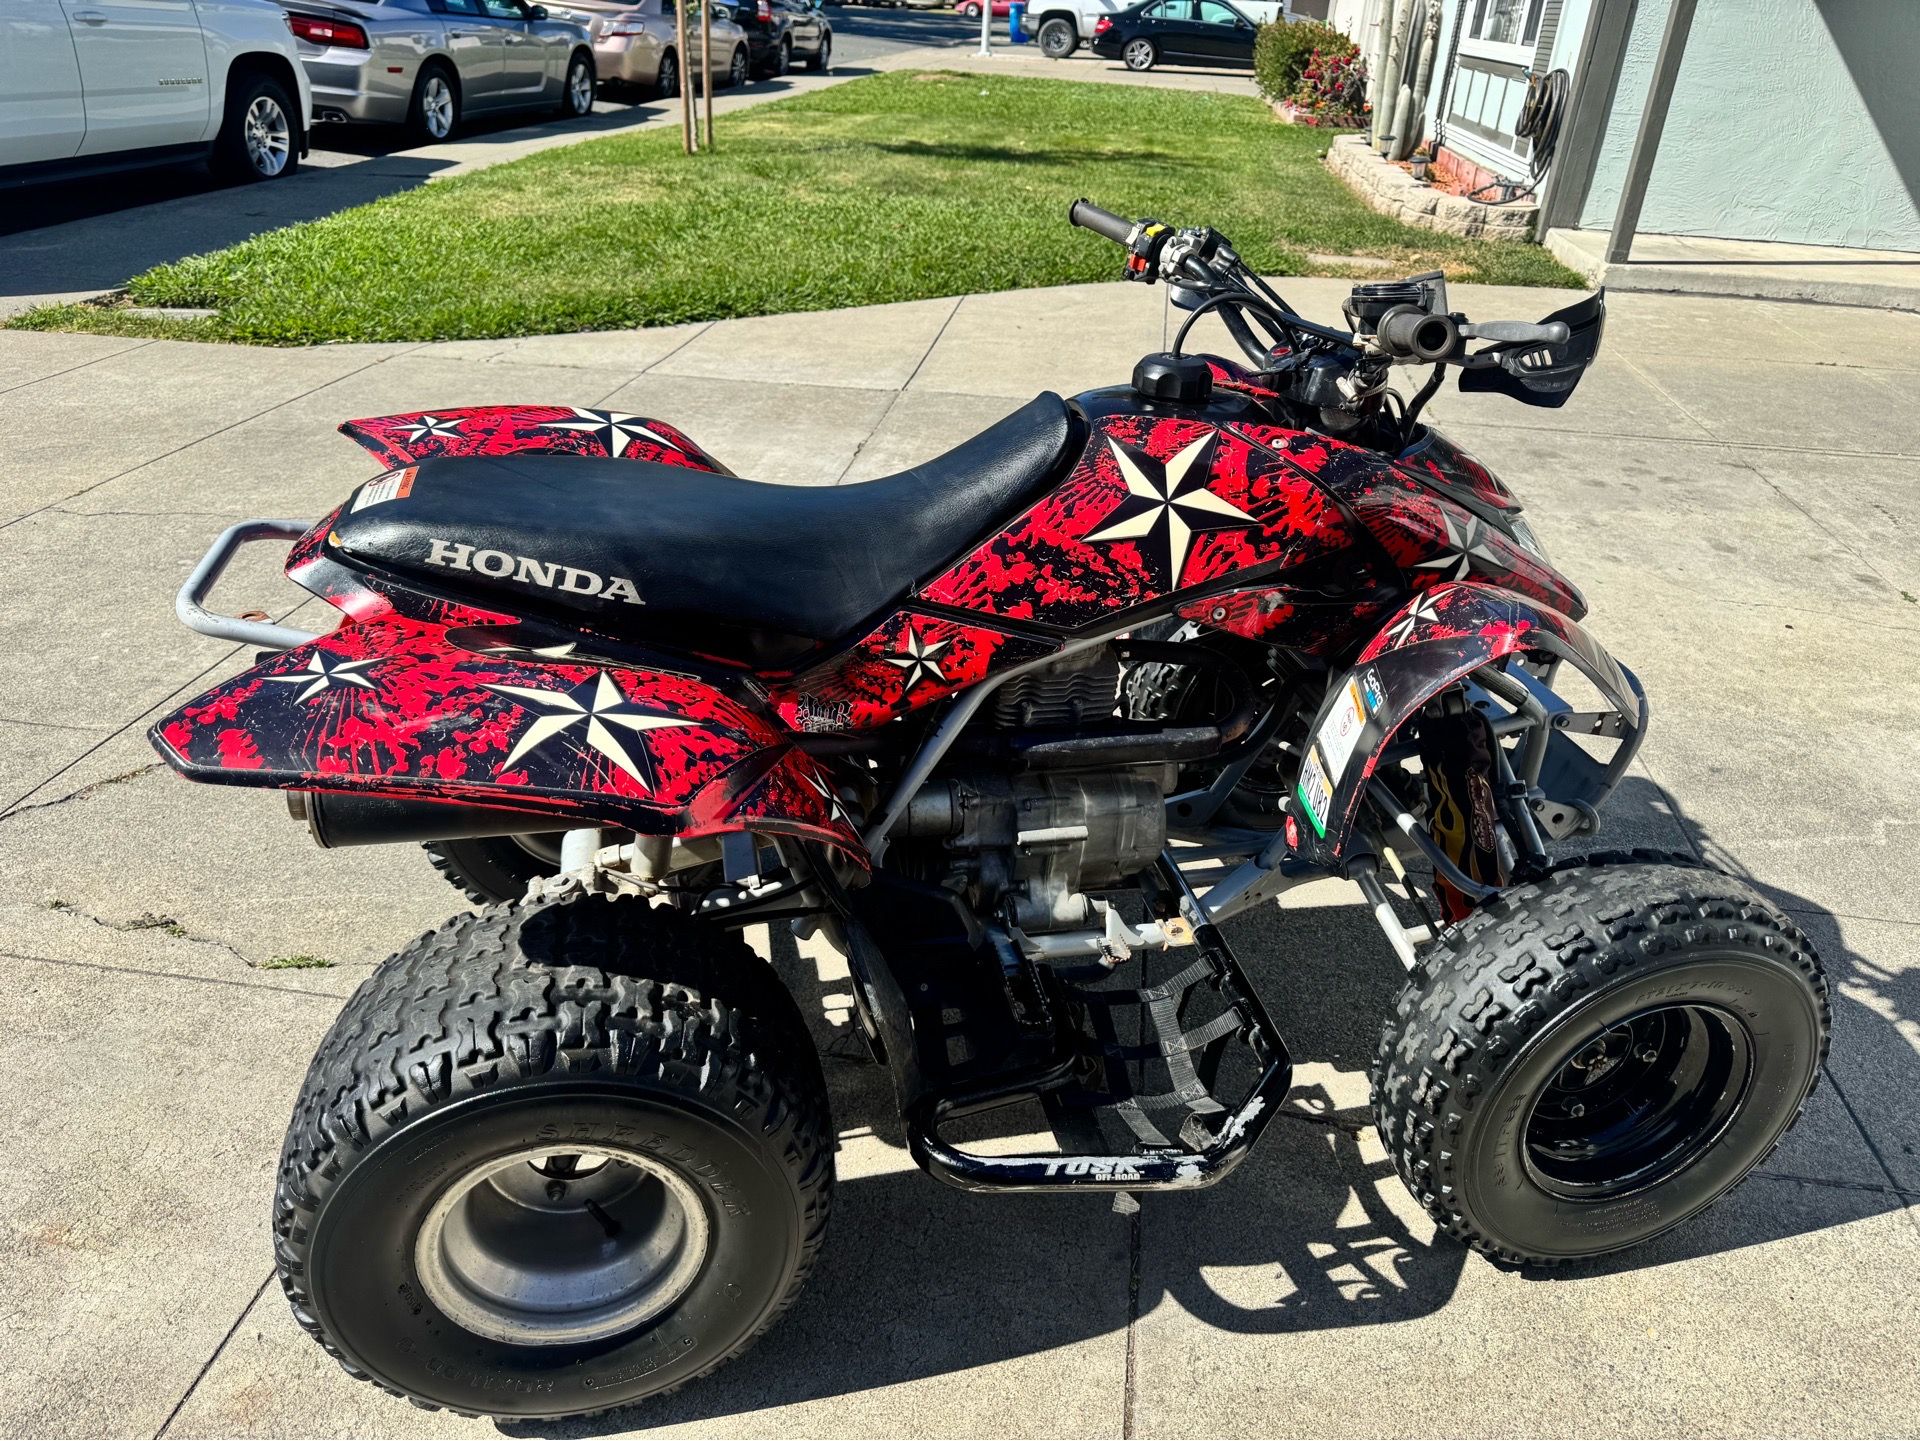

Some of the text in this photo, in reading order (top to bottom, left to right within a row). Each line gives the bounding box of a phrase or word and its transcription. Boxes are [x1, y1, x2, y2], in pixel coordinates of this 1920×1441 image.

[424, 538, 646, 605] HONDA
[1366, 667, 1384, 707] GoPro
[1044, 1156, 1141, 1176] TUSK
[1095, 1173, 1141, 1182] OFF-ROAD
